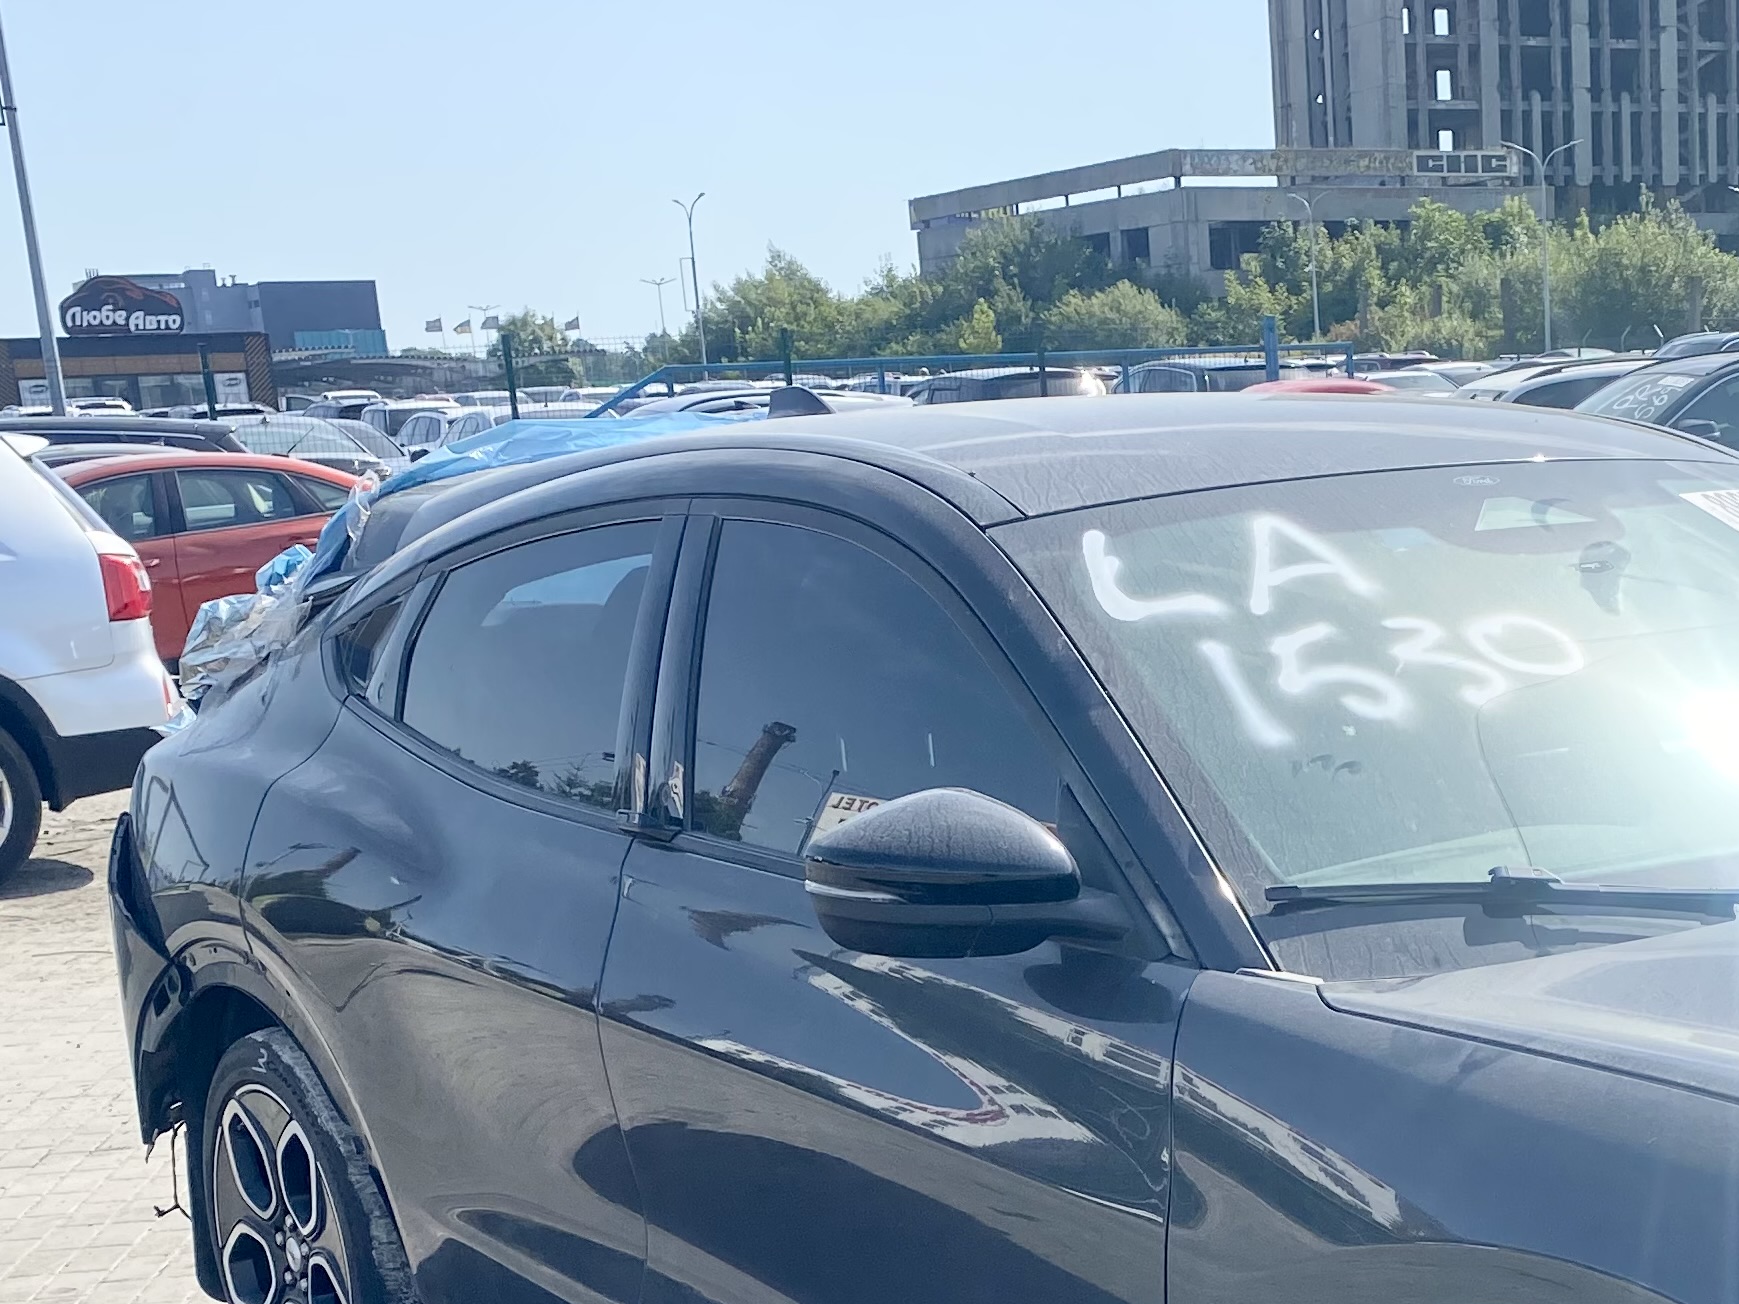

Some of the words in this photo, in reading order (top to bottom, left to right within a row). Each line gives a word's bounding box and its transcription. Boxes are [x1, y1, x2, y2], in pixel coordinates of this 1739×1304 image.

[65, 305, 126, 328] Любе
[128, 311, 182, 333] Авто
[1201, 613, 1584, 748] 1530
